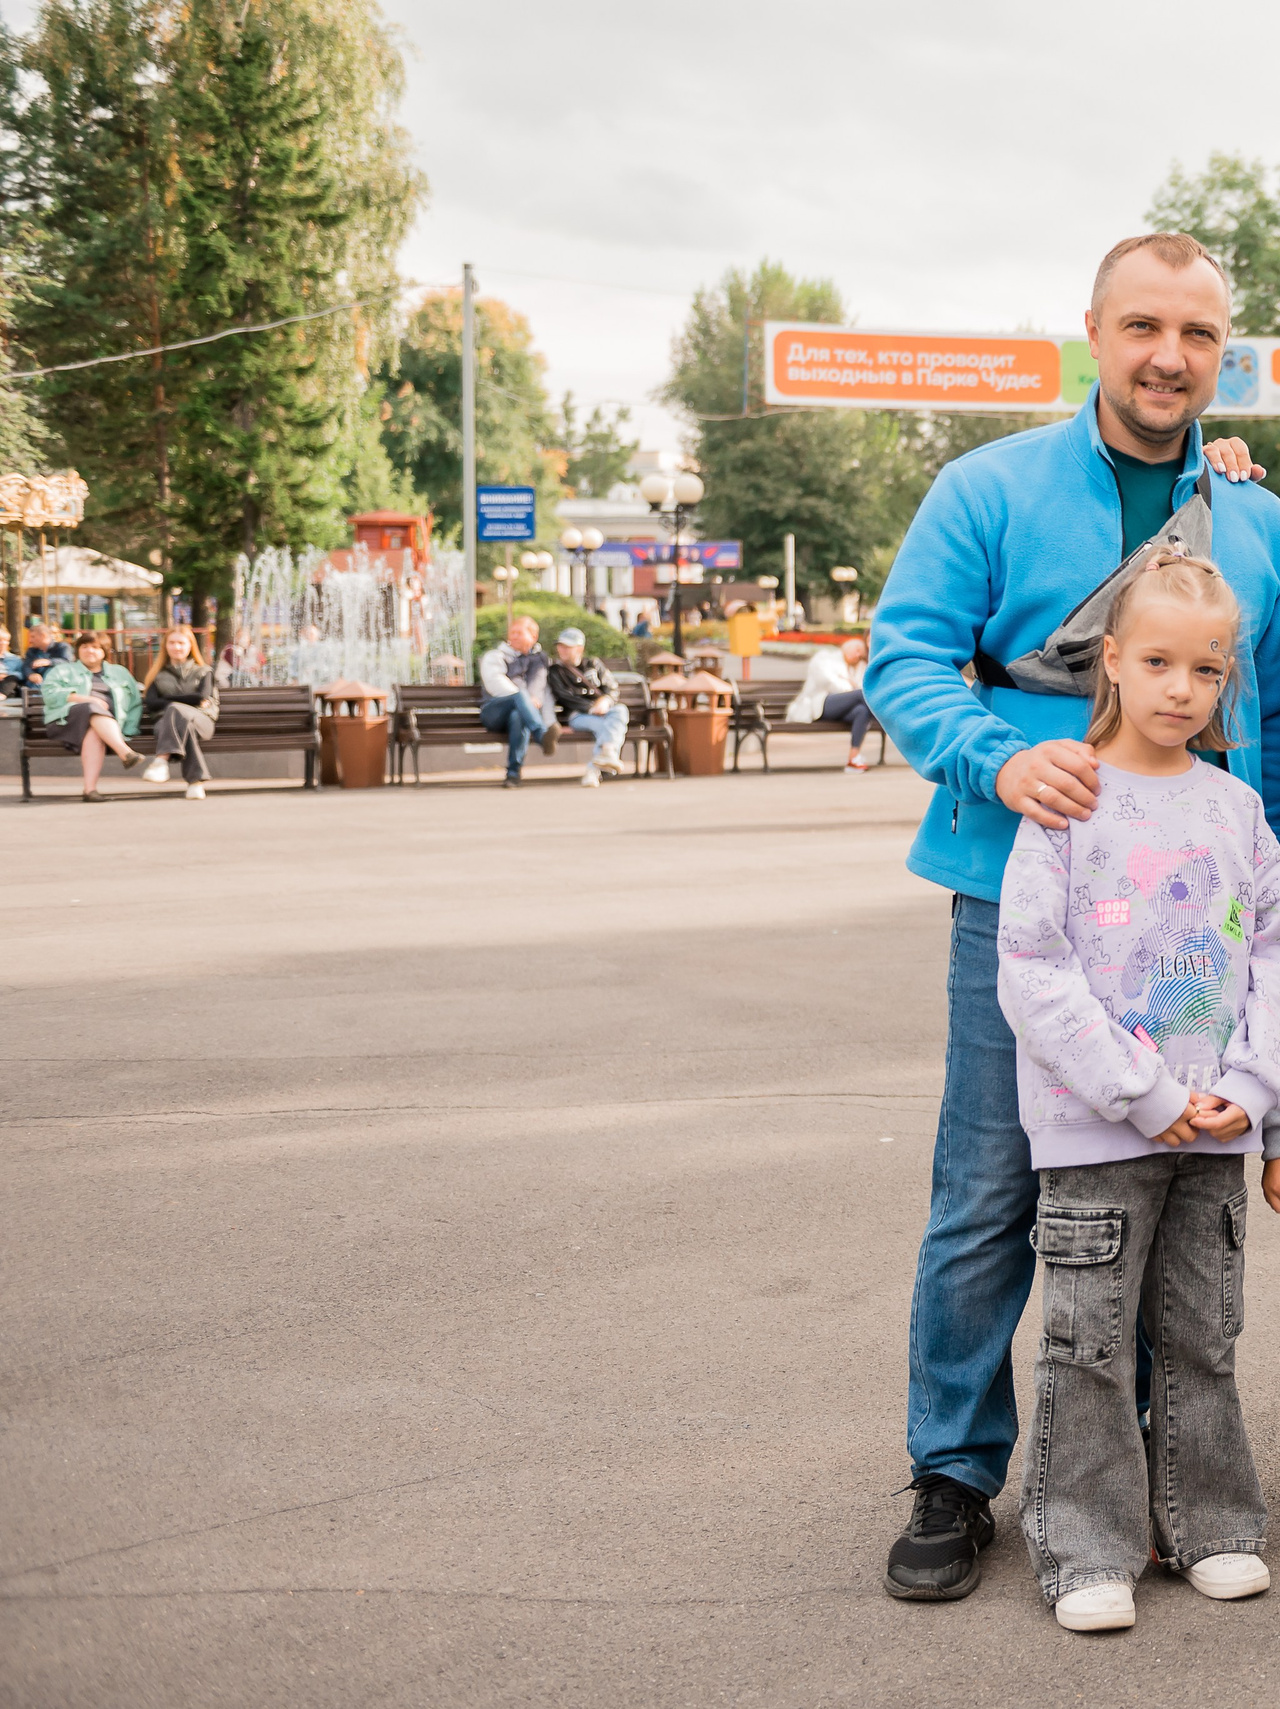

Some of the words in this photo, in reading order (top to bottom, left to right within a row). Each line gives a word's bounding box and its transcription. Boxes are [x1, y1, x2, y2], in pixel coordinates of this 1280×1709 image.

[787, 343, 830, 364] Для
[833, 348, 874, 366] тех,
[878, 351, 913, 366] кто
[917, 353, 1016, 371] проводит
[788, 366, 897, 386] выходные
[902, 371, 914, 385] в
[917, 369, 979, 390] Парке
[981, 370, 1041, 392] Чудес
[1097, 901, 1129, 913] GOOD
[1099, 912, 1129, 925] LUCK
[1160, 955, 1212, 979] LOVE
